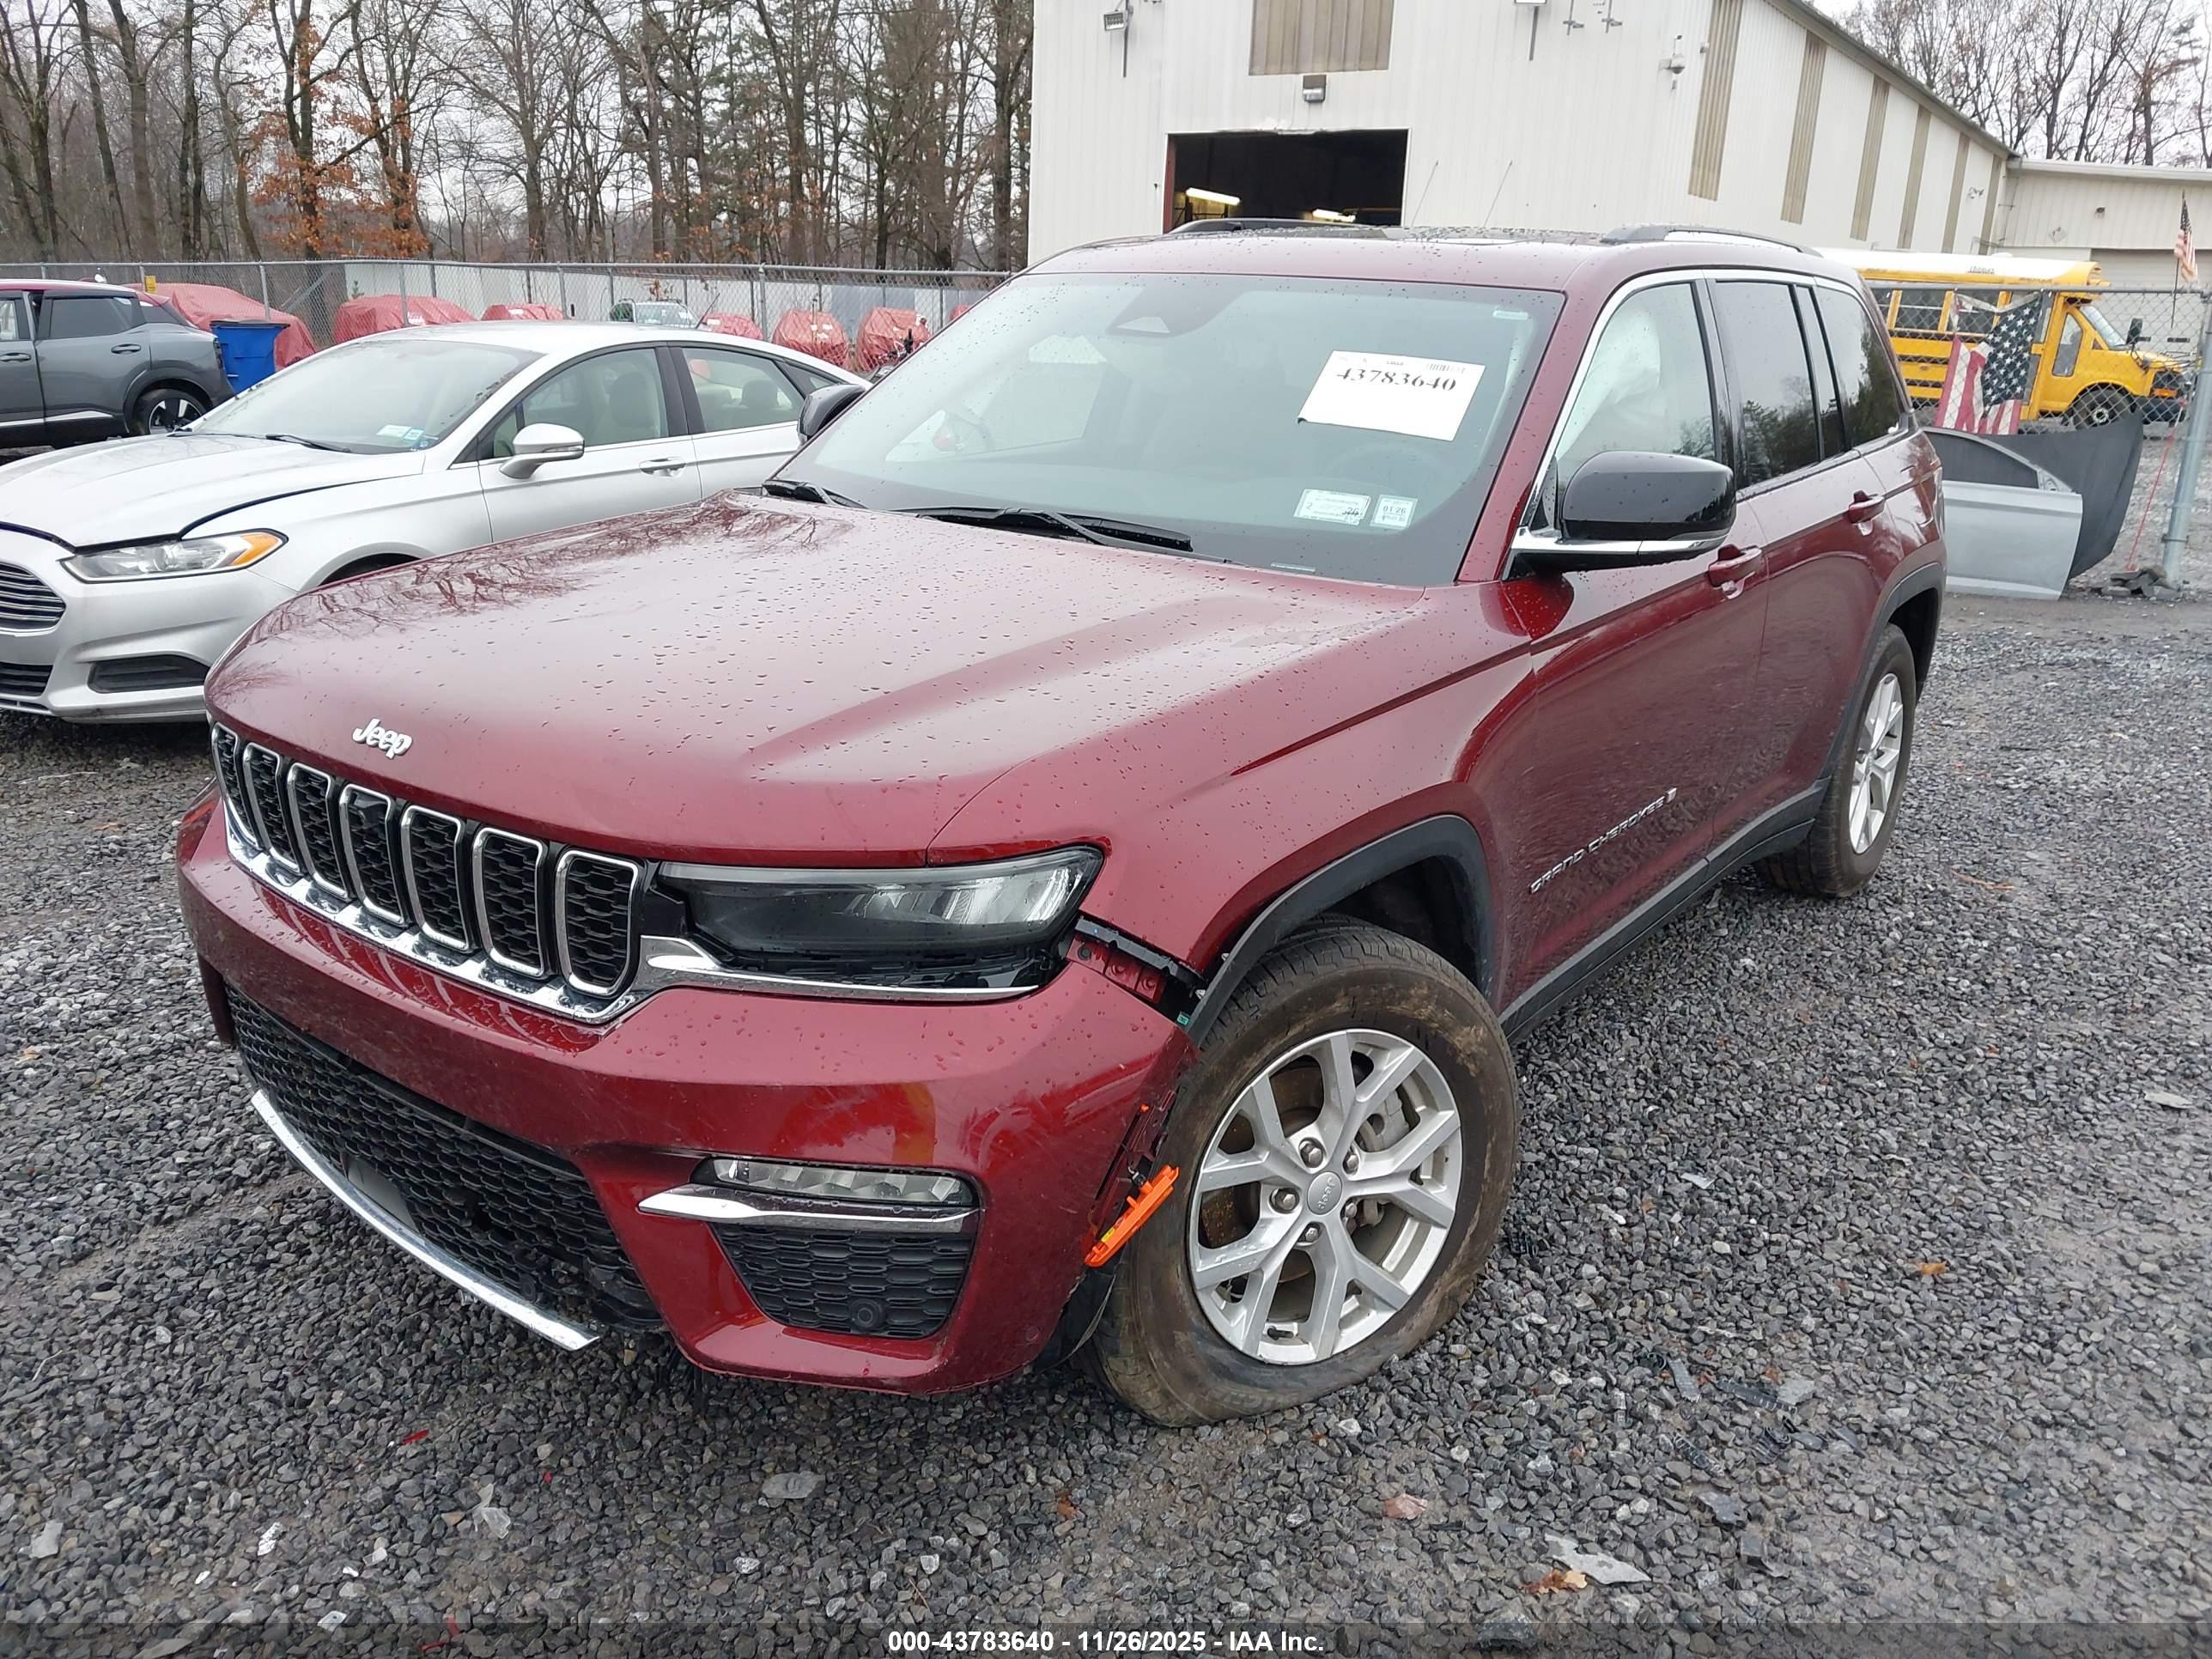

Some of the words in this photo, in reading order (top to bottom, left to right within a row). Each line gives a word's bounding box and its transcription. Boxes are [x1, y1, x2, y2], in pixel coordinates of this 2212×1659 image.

[1336, 367, 1457, 392] 43783640
[352, 718, 412, 760] Jeep
[1530, 848, 1585, 894] GRAND
[1587, 795, 1666, 854] CHEROKEE
[1317, 1176, 1335, 1210] Jeep
